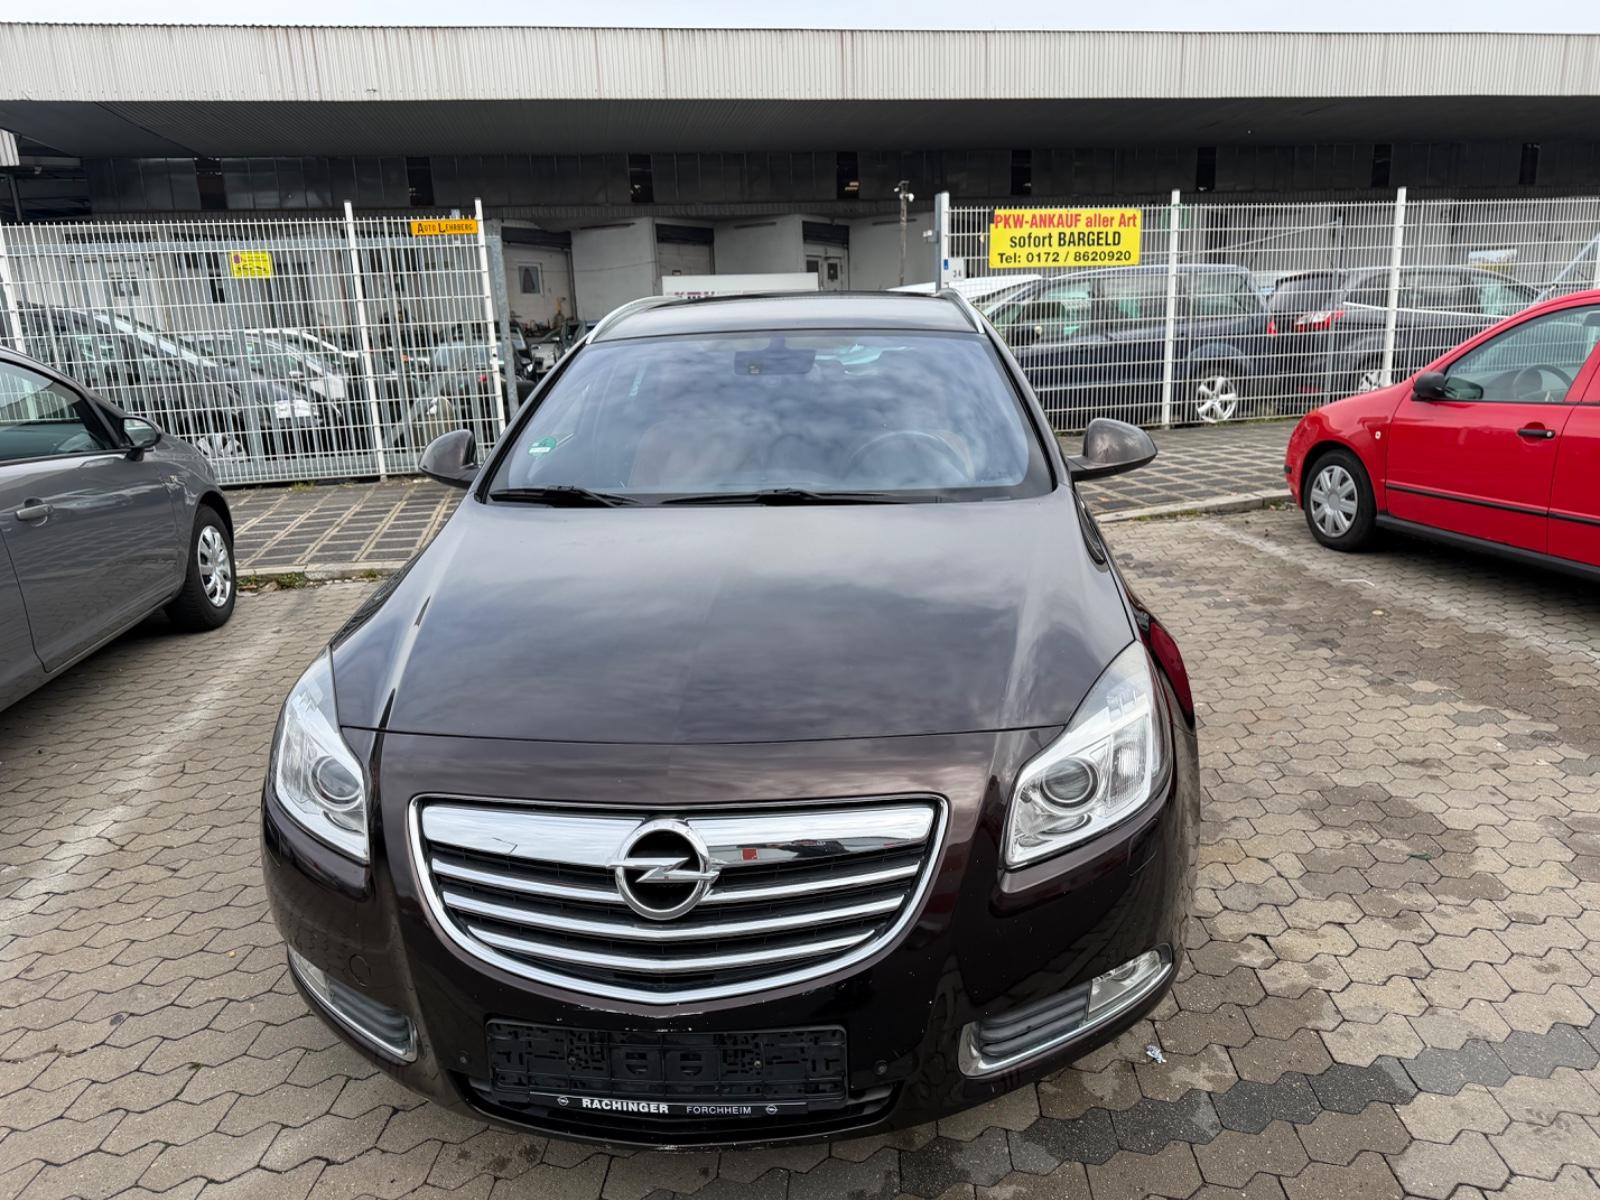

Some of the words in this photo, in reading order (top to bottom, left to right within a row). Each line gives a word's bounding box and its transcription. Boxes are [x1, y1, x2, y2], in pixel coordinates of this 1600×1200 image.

[994, 213, 1082, 229] PKW-ANKAUF
[1086, 213, 1115, 228] aller
[1118, 212, 1137, 228] Art
[1009, 232, 1053, 248] sofort
[1058, 231, 1121, 247] BARGELD
[997, 252, 1021, 264] Tel:
[1026, 251, 1060, 263] 0172
[1064, 250, 1070, 262] /
[1073, 250, 1132, 262] 8620920
[581, 1097, 669, 1114] RACHINGER
[686, 1105, 752, 1114] FORCHHEIM
